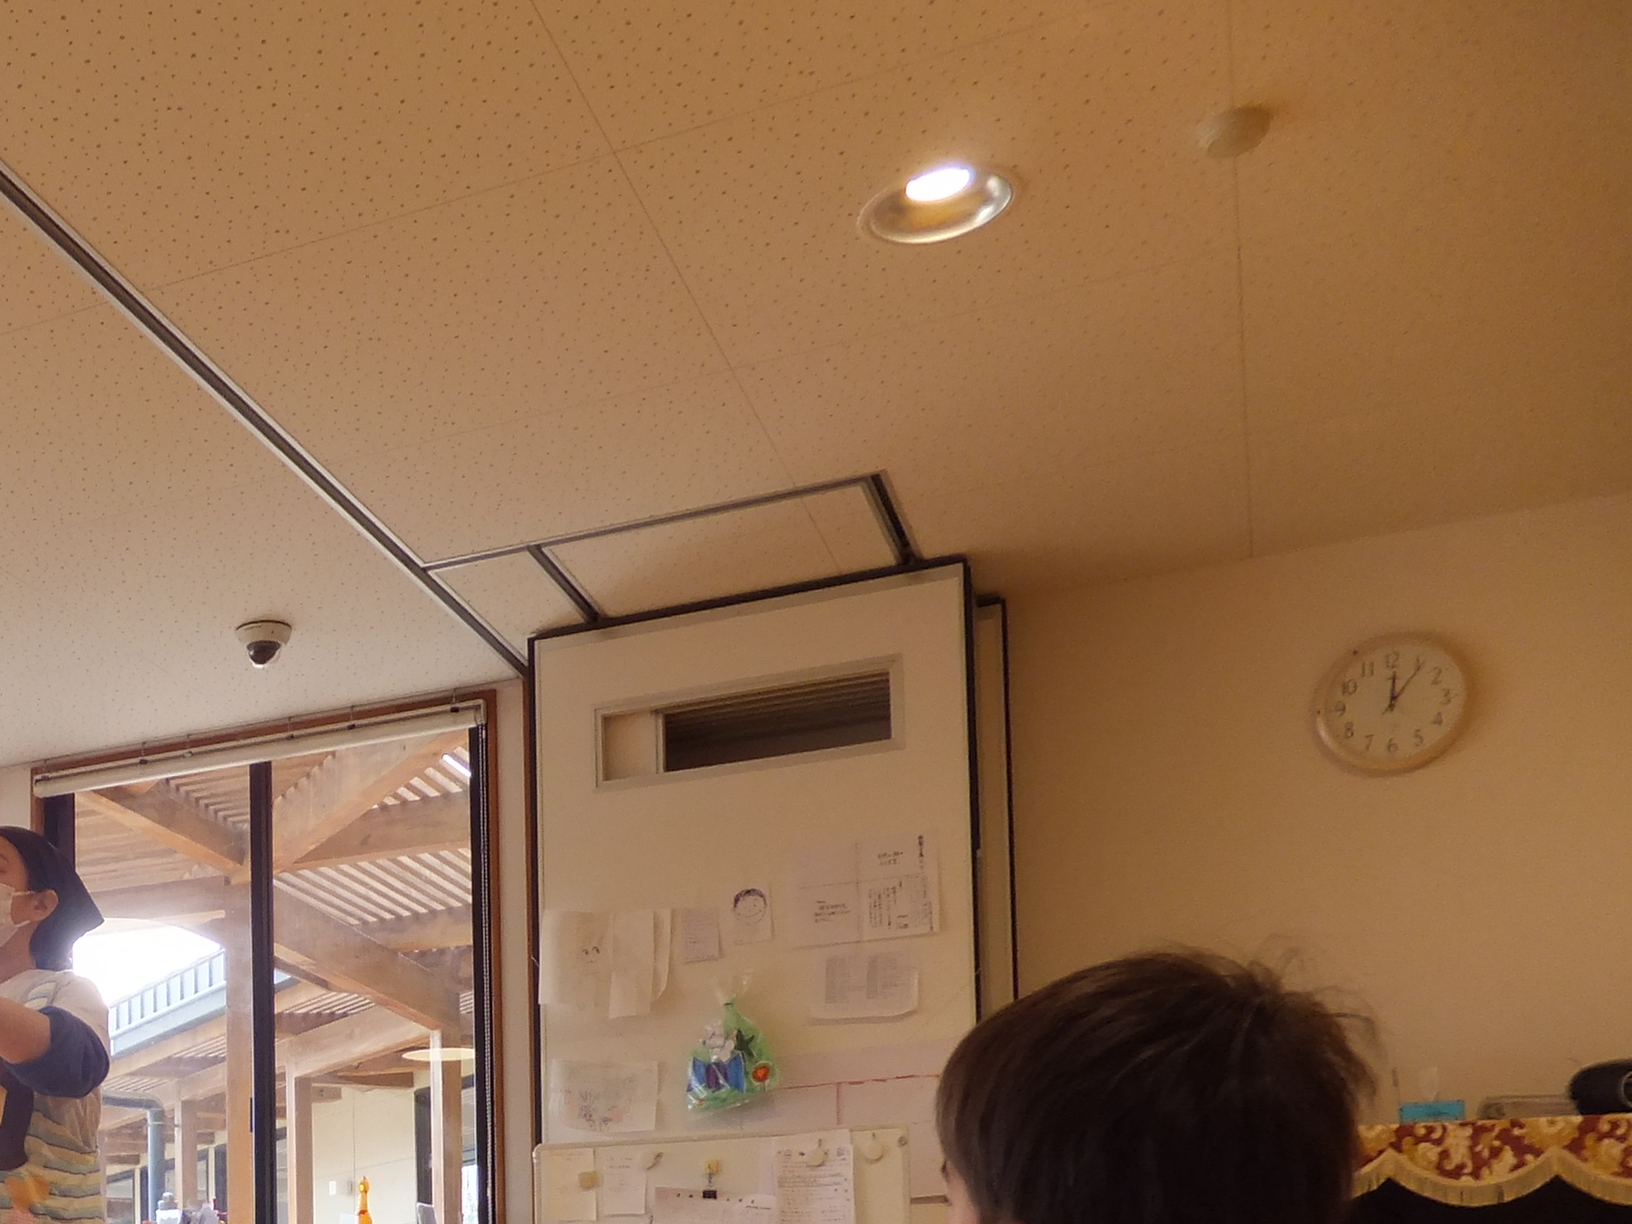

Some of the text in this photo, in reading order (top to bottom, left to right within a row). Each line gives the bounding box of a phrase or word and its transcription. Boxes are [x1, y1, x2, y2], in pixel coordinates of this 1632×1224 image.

[1360, 662, 1374, 678] 11
[1429, 667, 1442, 685] 2
[1342, 679, 1357, 696] 10
[1442, 688, 1452, 705] 3
[1431, 712, 1443, 726] 4
[1344, 721, 1355, 739] 8
[1414, 729, 1424, 746] 5
[1365, 734, 1374, 751] 7
[1387, 738, 1398, 754] 6
